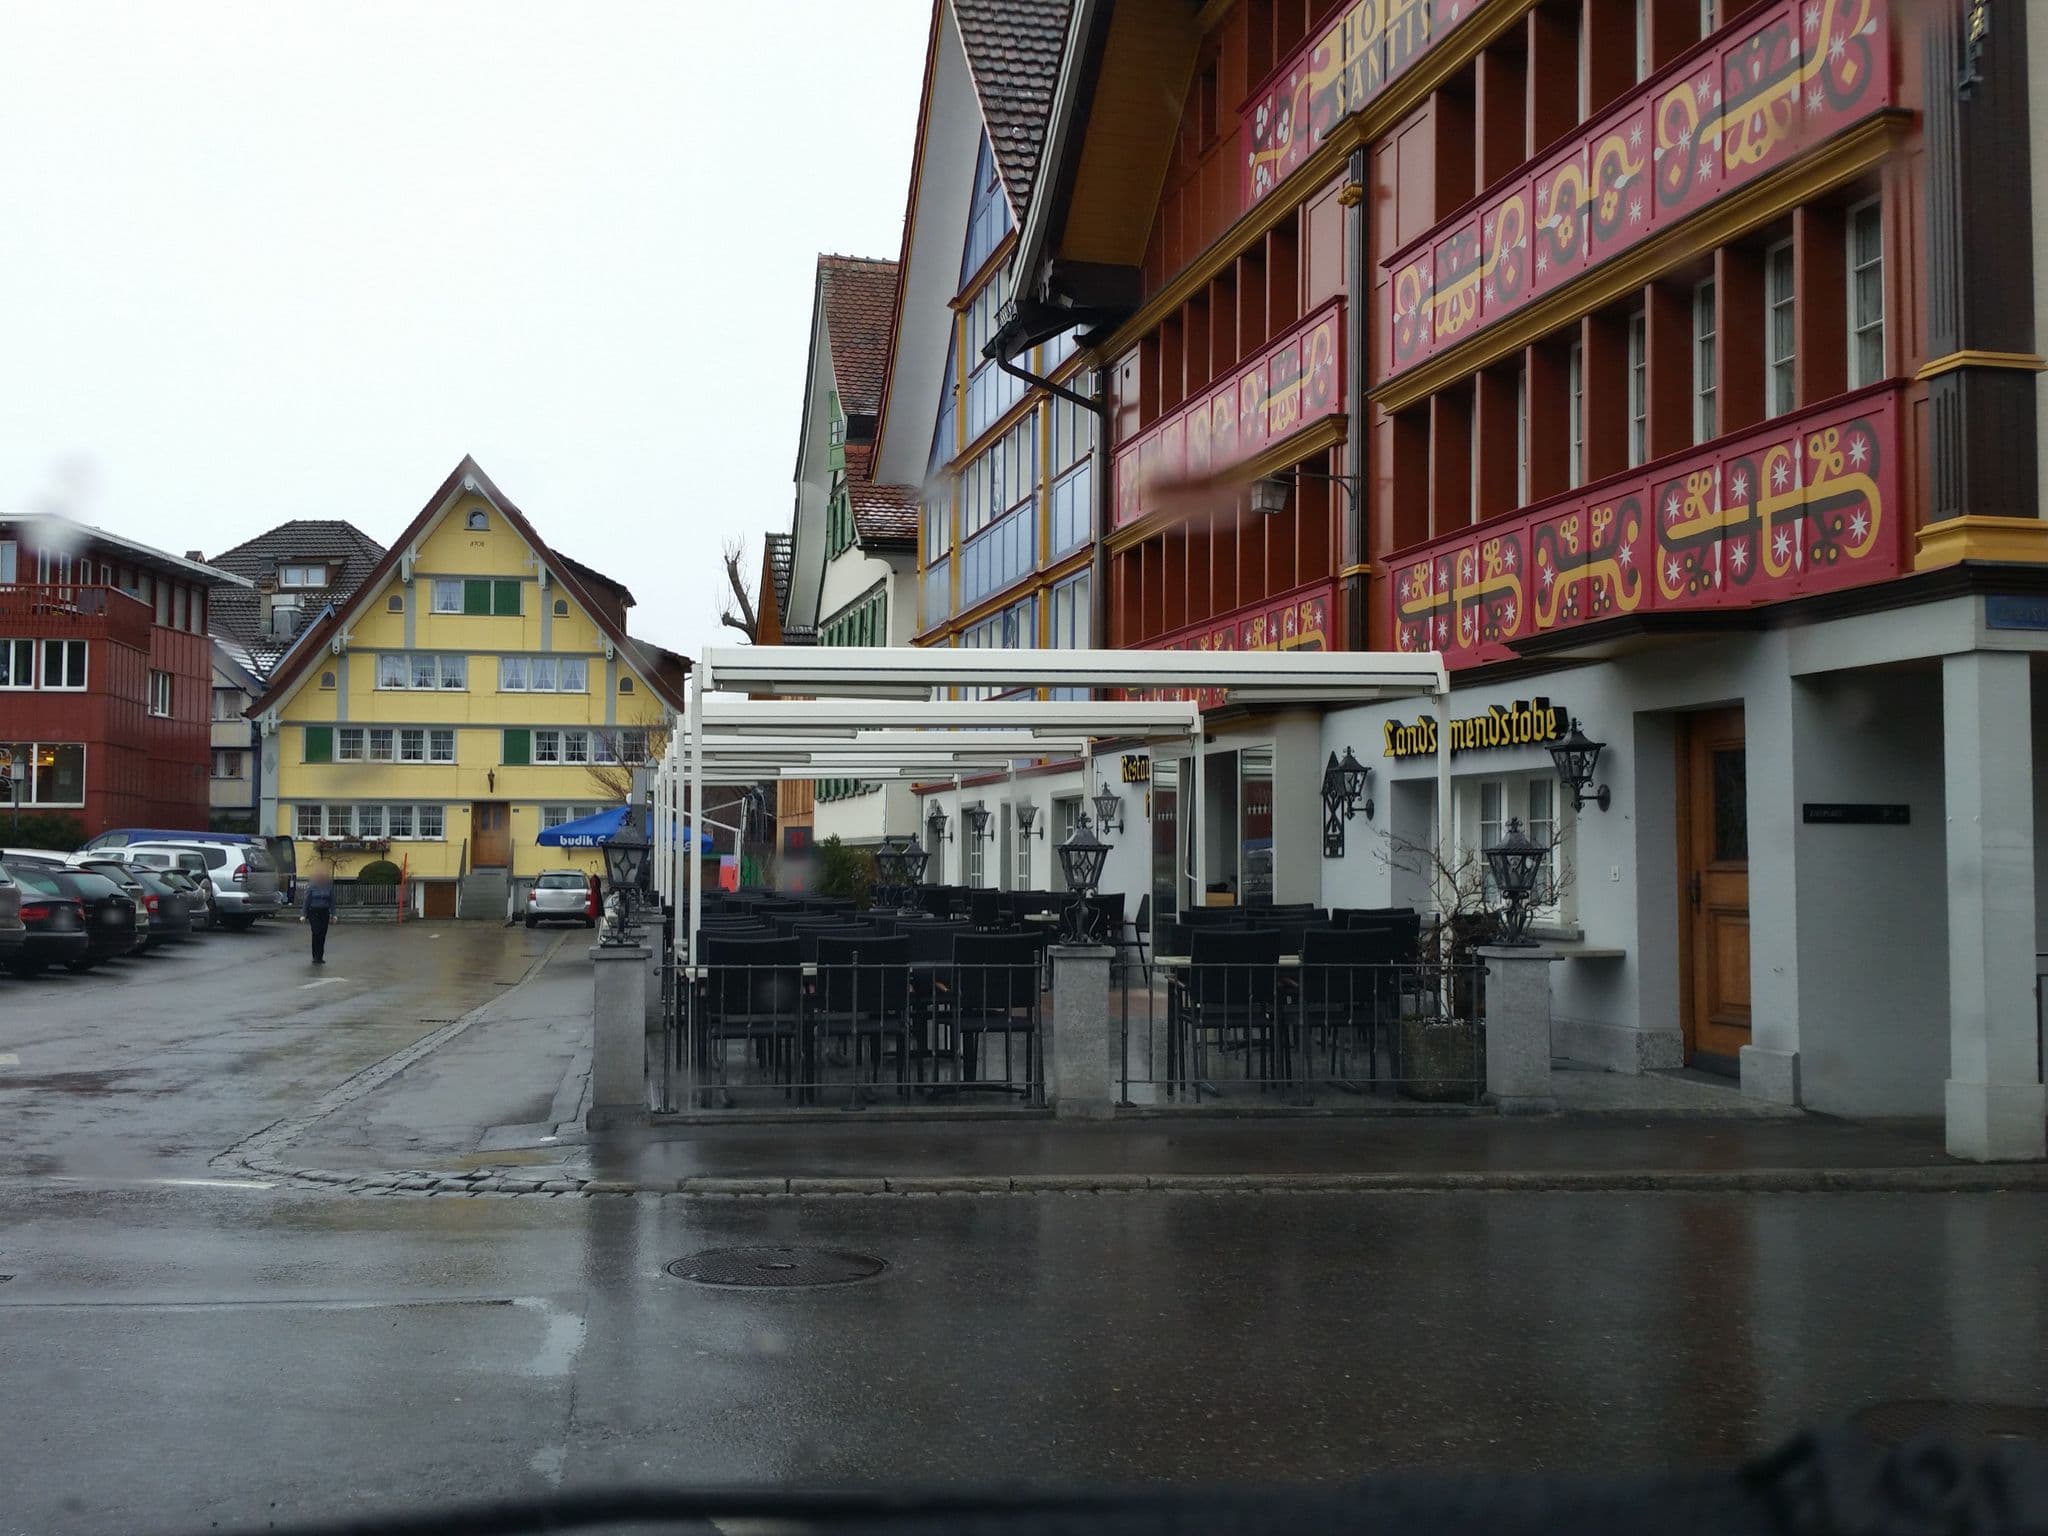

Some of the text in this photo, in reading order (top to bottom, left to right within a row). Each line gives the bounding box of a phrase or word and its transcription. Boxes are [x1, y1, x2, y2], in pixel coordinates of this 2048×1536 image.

[1340, 0, 1413, 63] HO
[1384, 697, 1559, 757] Landsmendstobe
[1120, 755, 1150, 783] Restau
[559, 835, 594, 846] budik
